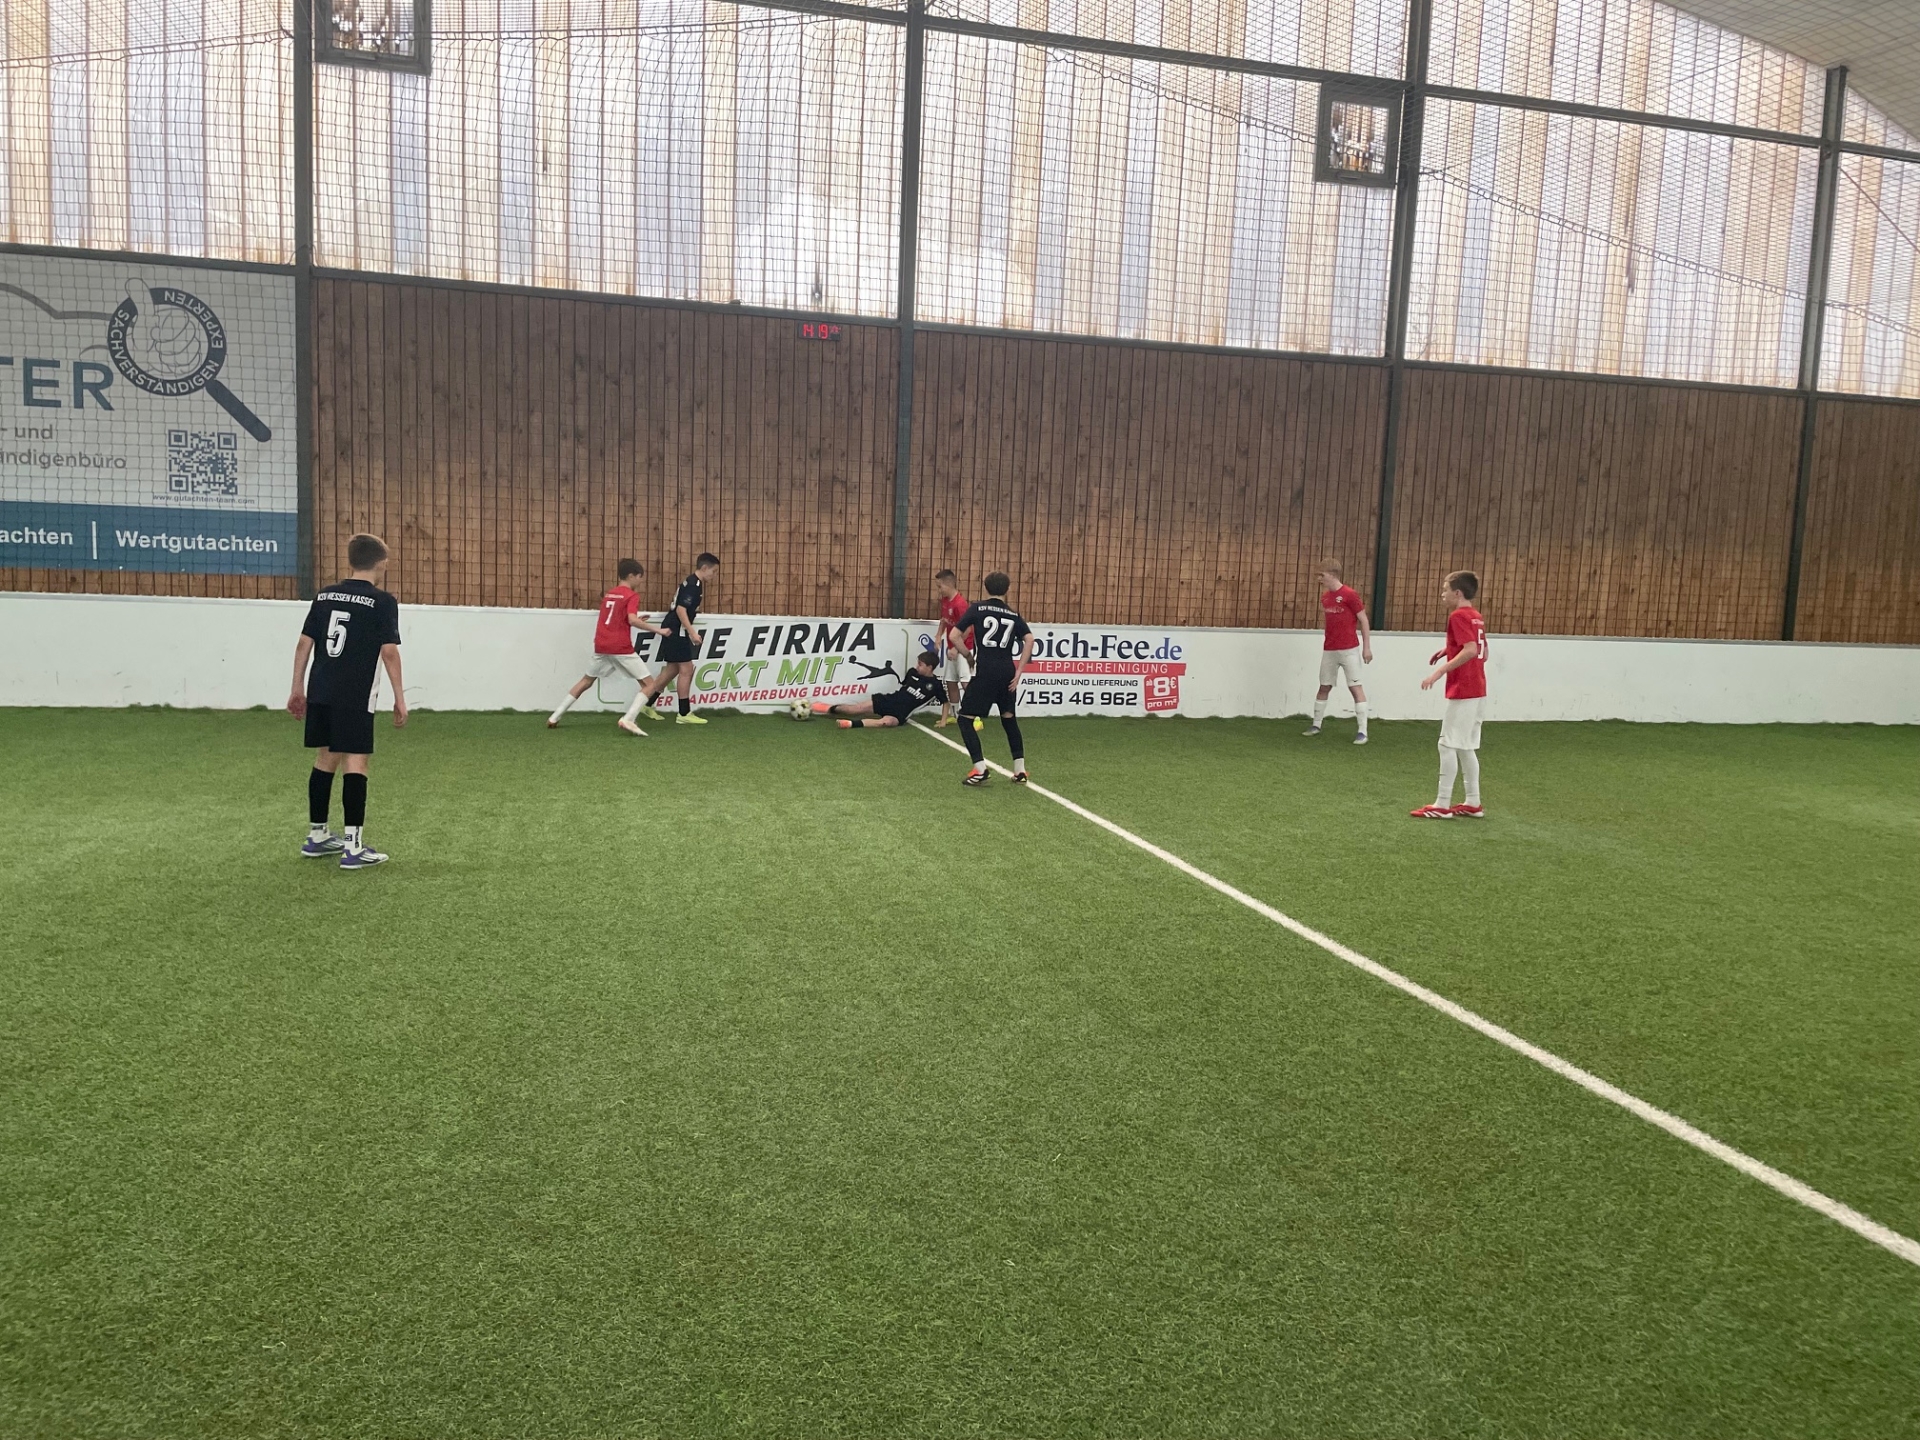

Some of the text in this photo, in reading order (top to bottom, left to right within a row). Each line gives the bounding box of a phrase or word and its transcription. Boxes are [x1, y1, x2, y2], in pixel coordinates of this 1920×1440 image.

[163, 289, 224, 350] EXPERTEN
[109, 308, 220, 394] SACHVERSTÄNDIGEN
[14, 424, 54, 440] und
[152, 494, 255, 505] www.gutachten-team.com
[115, 530, 278, 553] Wertgutachten
[327, 592, 351, 602] HESSEN
[351, 594, 375, 608] KASSEL
[604, 600, 616, 625] 7
[326, 609, 351, 658] 5
[746, 622, 876, 657] FIRMA
[982, 615, 1015, 648] 27
[660, 656, 845, 693] CKT MIT
[1038, 661, 1169, 675] TEPPICHREINIGUNG
[1021, 678, 1138, 687] ABHOLUNG UND LIEFERUNG
[688, 687, 809, 705] ANDENWERBUNG
[812, 684, 868, 697] BUCHEN
[1069, 691, 1094, 706] 46
[1100, 692, 1138, 706] 962
[1146, 700, 1162, 709] pro
